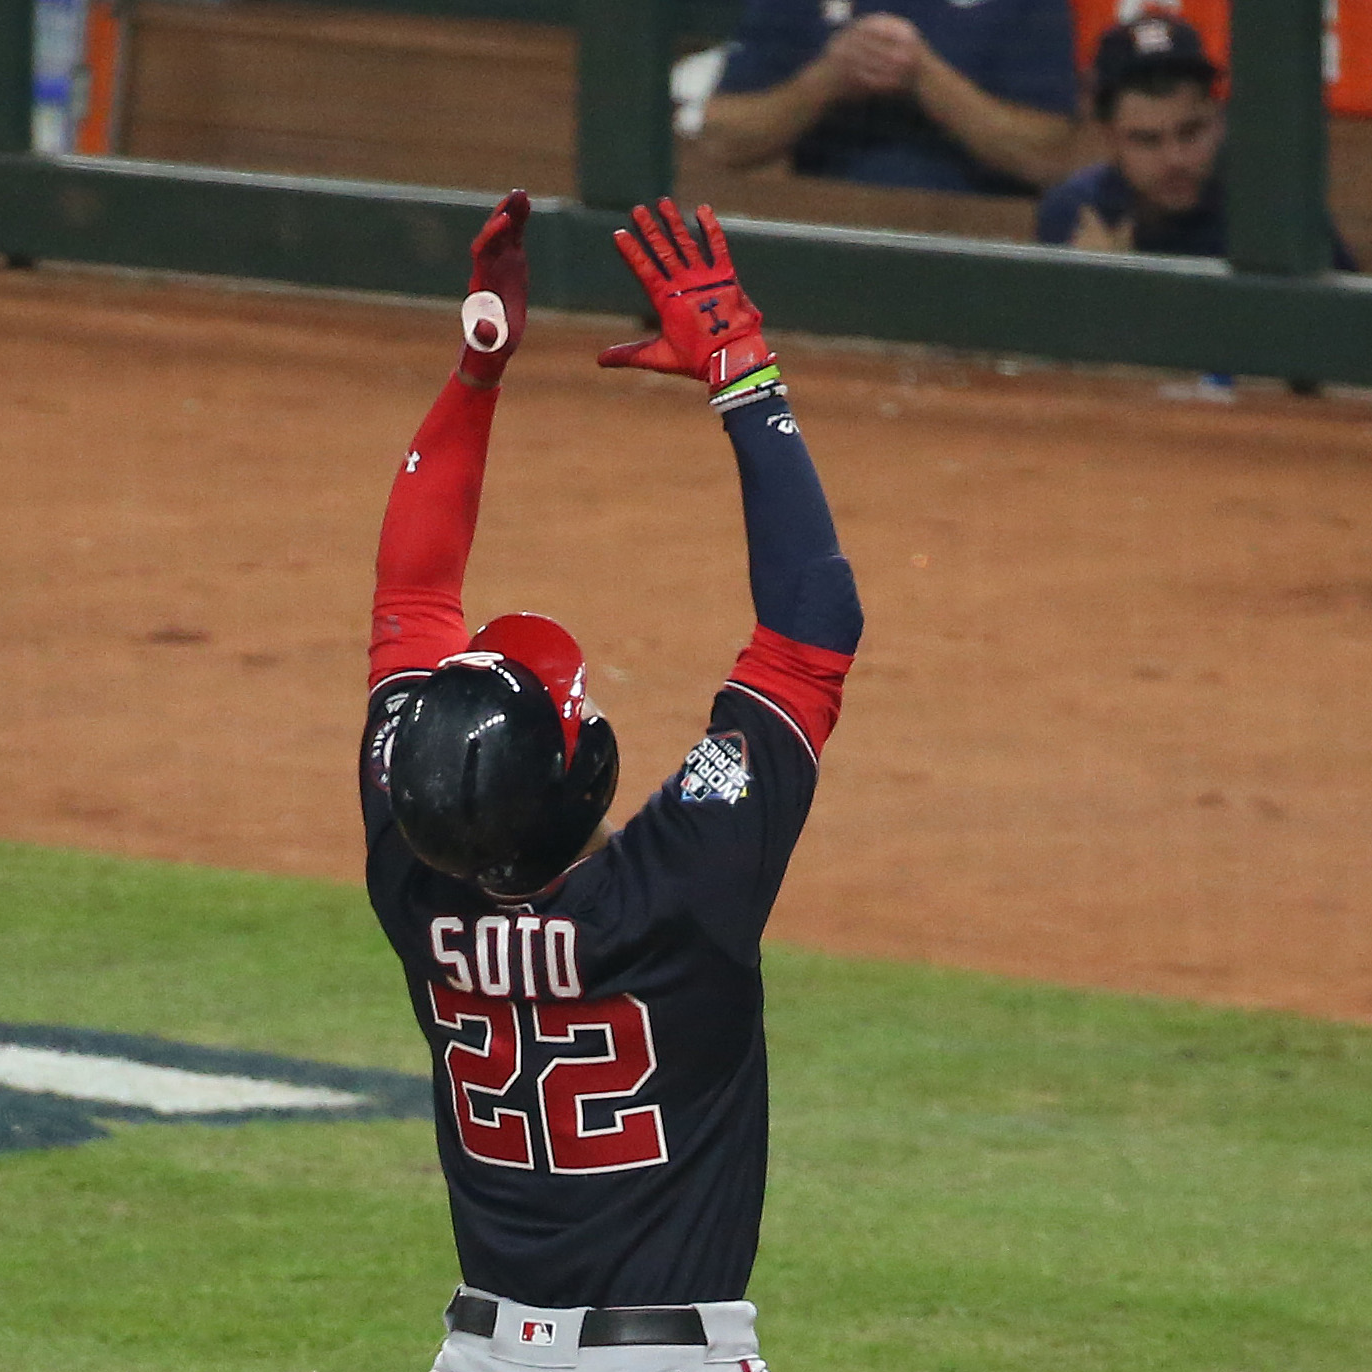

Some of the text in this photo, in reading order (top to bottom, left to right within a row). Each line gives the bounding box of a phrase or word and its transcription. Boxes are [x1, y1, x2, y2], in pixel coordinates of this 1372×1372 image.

[684, 749, 741, 804] WORLD
[698, 737, 751, 788] SERIES
[429, 915, 585, 999] SOTO
[427, 978, 669, 1175] 22
